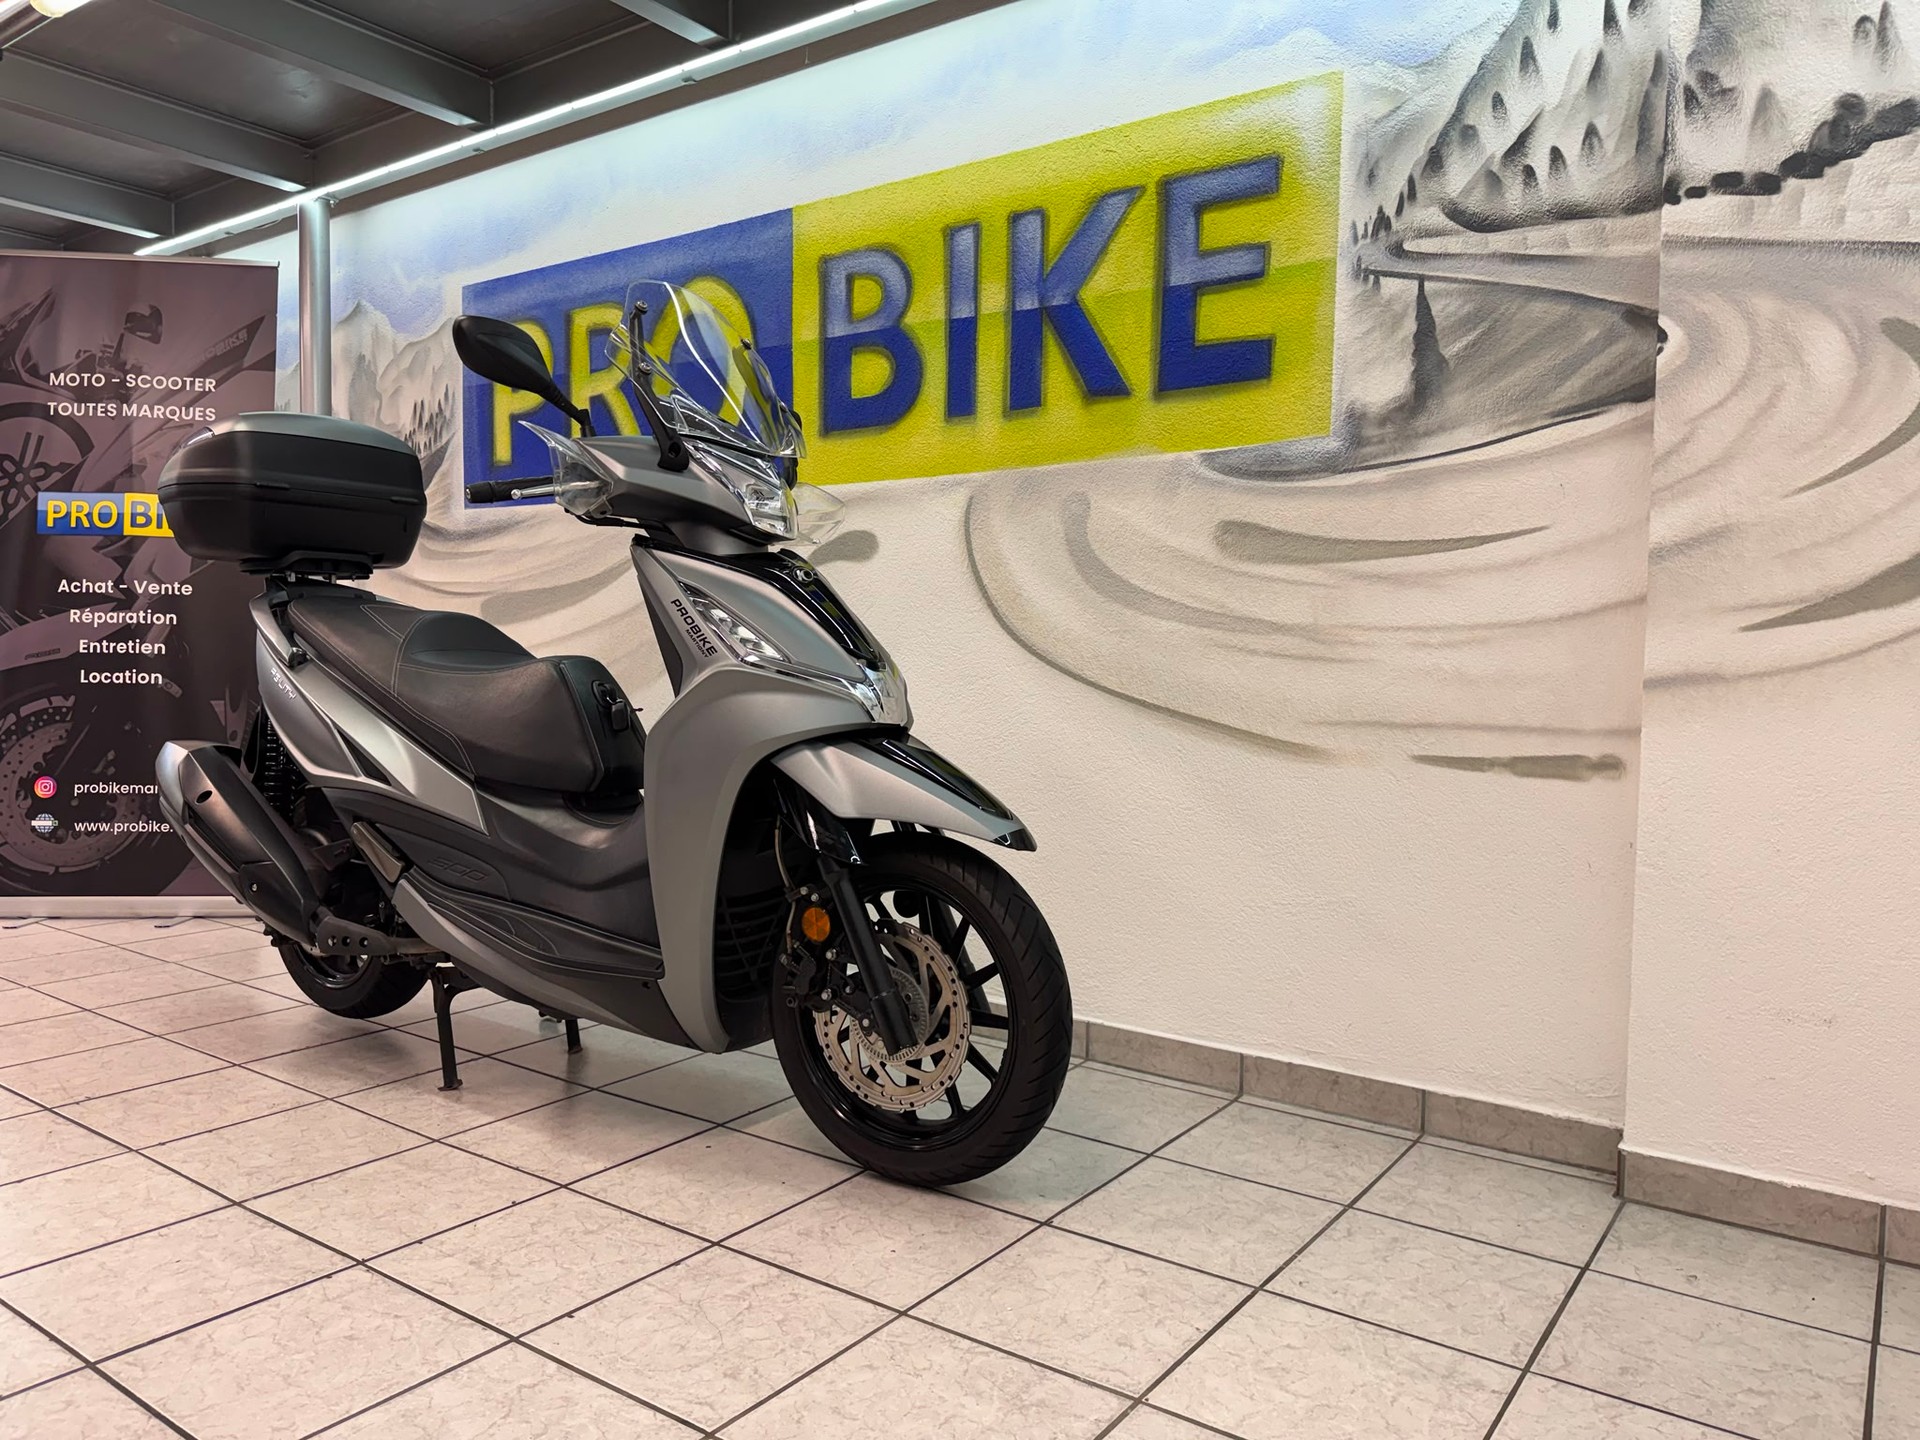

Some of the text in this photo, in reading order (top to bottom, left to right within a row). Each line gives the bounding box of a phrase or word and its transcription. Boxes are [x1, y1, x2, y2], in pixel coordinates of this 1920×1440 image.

[819, 155, 1283, 438] BIKE
[49, 372, 106, 388] MOTO
[125, 373, 216, 393] SCOOTER
[47, 401, 217, 422] TOUTES MARQUES
[46, 499, 164, 529] PRO BI
[57, 578, 114, 595] Achat
[133, 579, 194, 596] Vente
[69, 607, 178, 628] Réparation
[670, 598, 718, 657] PROBIKE
[79, 638, 166, 655] Entretien
[685, 628, 709, 658] MARTIGNY
[80, 668, 163, 686] Location
[74, 820, 174, 836] www.probike.
